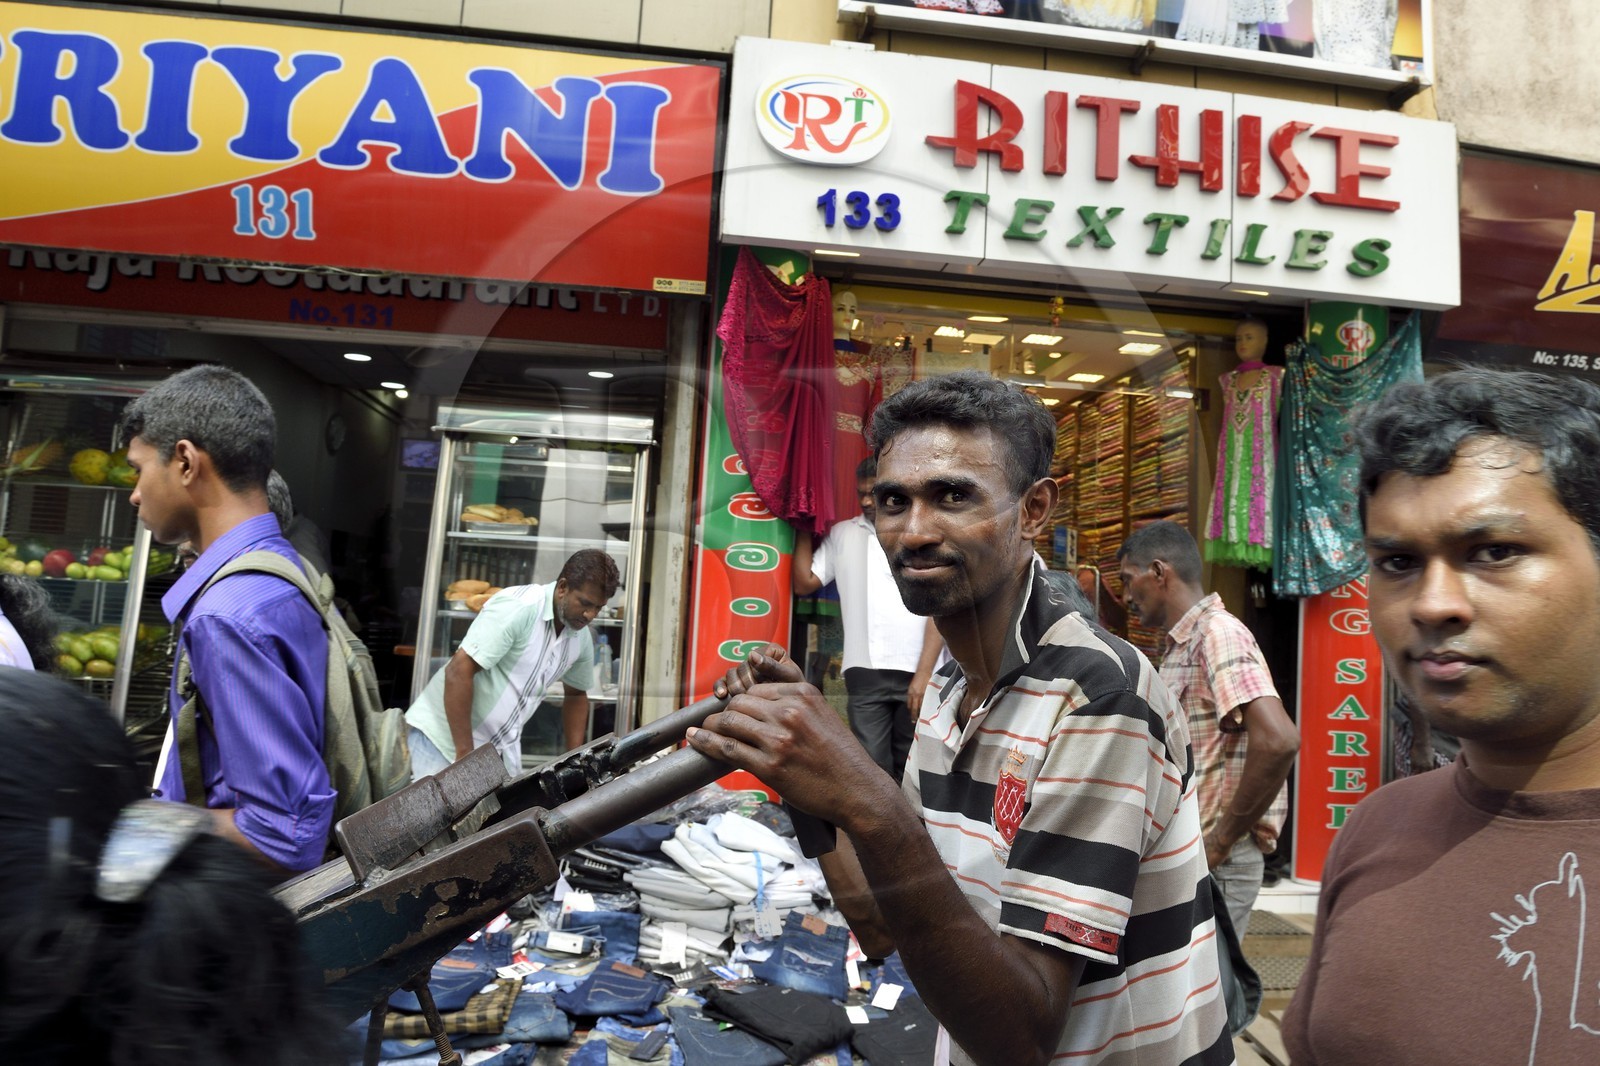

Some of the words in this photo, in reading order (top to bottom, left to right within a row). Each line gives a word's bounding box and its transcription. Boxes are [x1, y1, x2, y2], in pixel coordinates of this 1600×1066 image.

[0, 28, 671, 197] RIYANI
[924, 79, 1401, 213] RITHISE
[230, 183, 317, 241] 131
[816, 188, 902, 232] 133
[942, 190, 1393, 278] TEXTILES
[1533, 351, 1558, 366] No:
